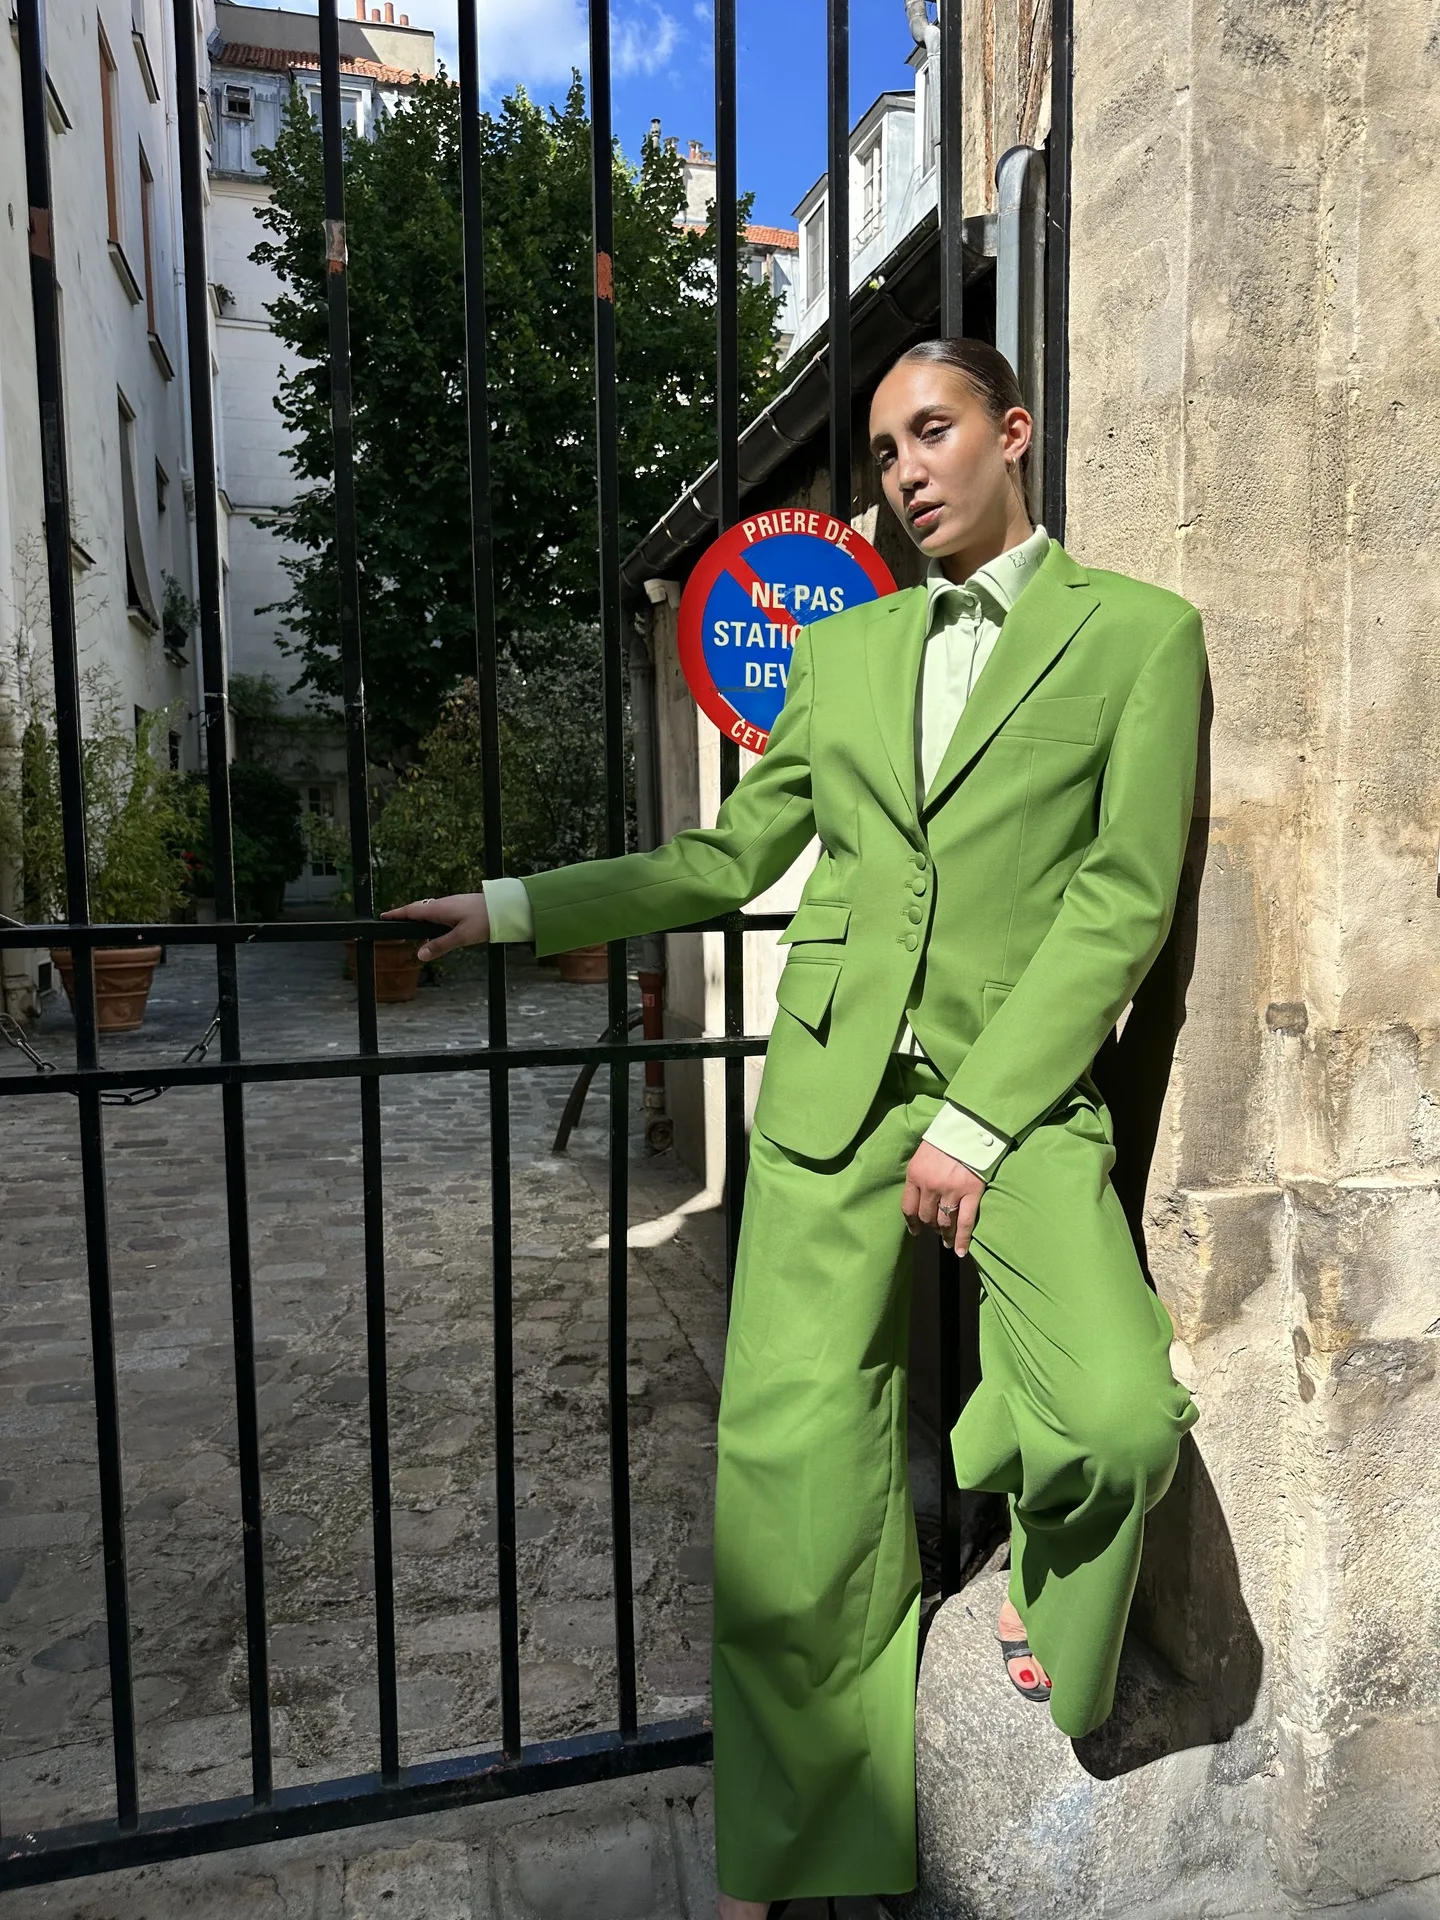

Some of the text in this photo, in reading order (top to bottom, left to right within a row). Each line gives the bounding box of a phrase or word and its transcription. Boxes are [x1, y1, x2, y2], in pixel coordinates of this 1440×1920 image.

[742, 511, 853, 550] PRIERE DE
[752, 581, 844, 613] NE PAS
